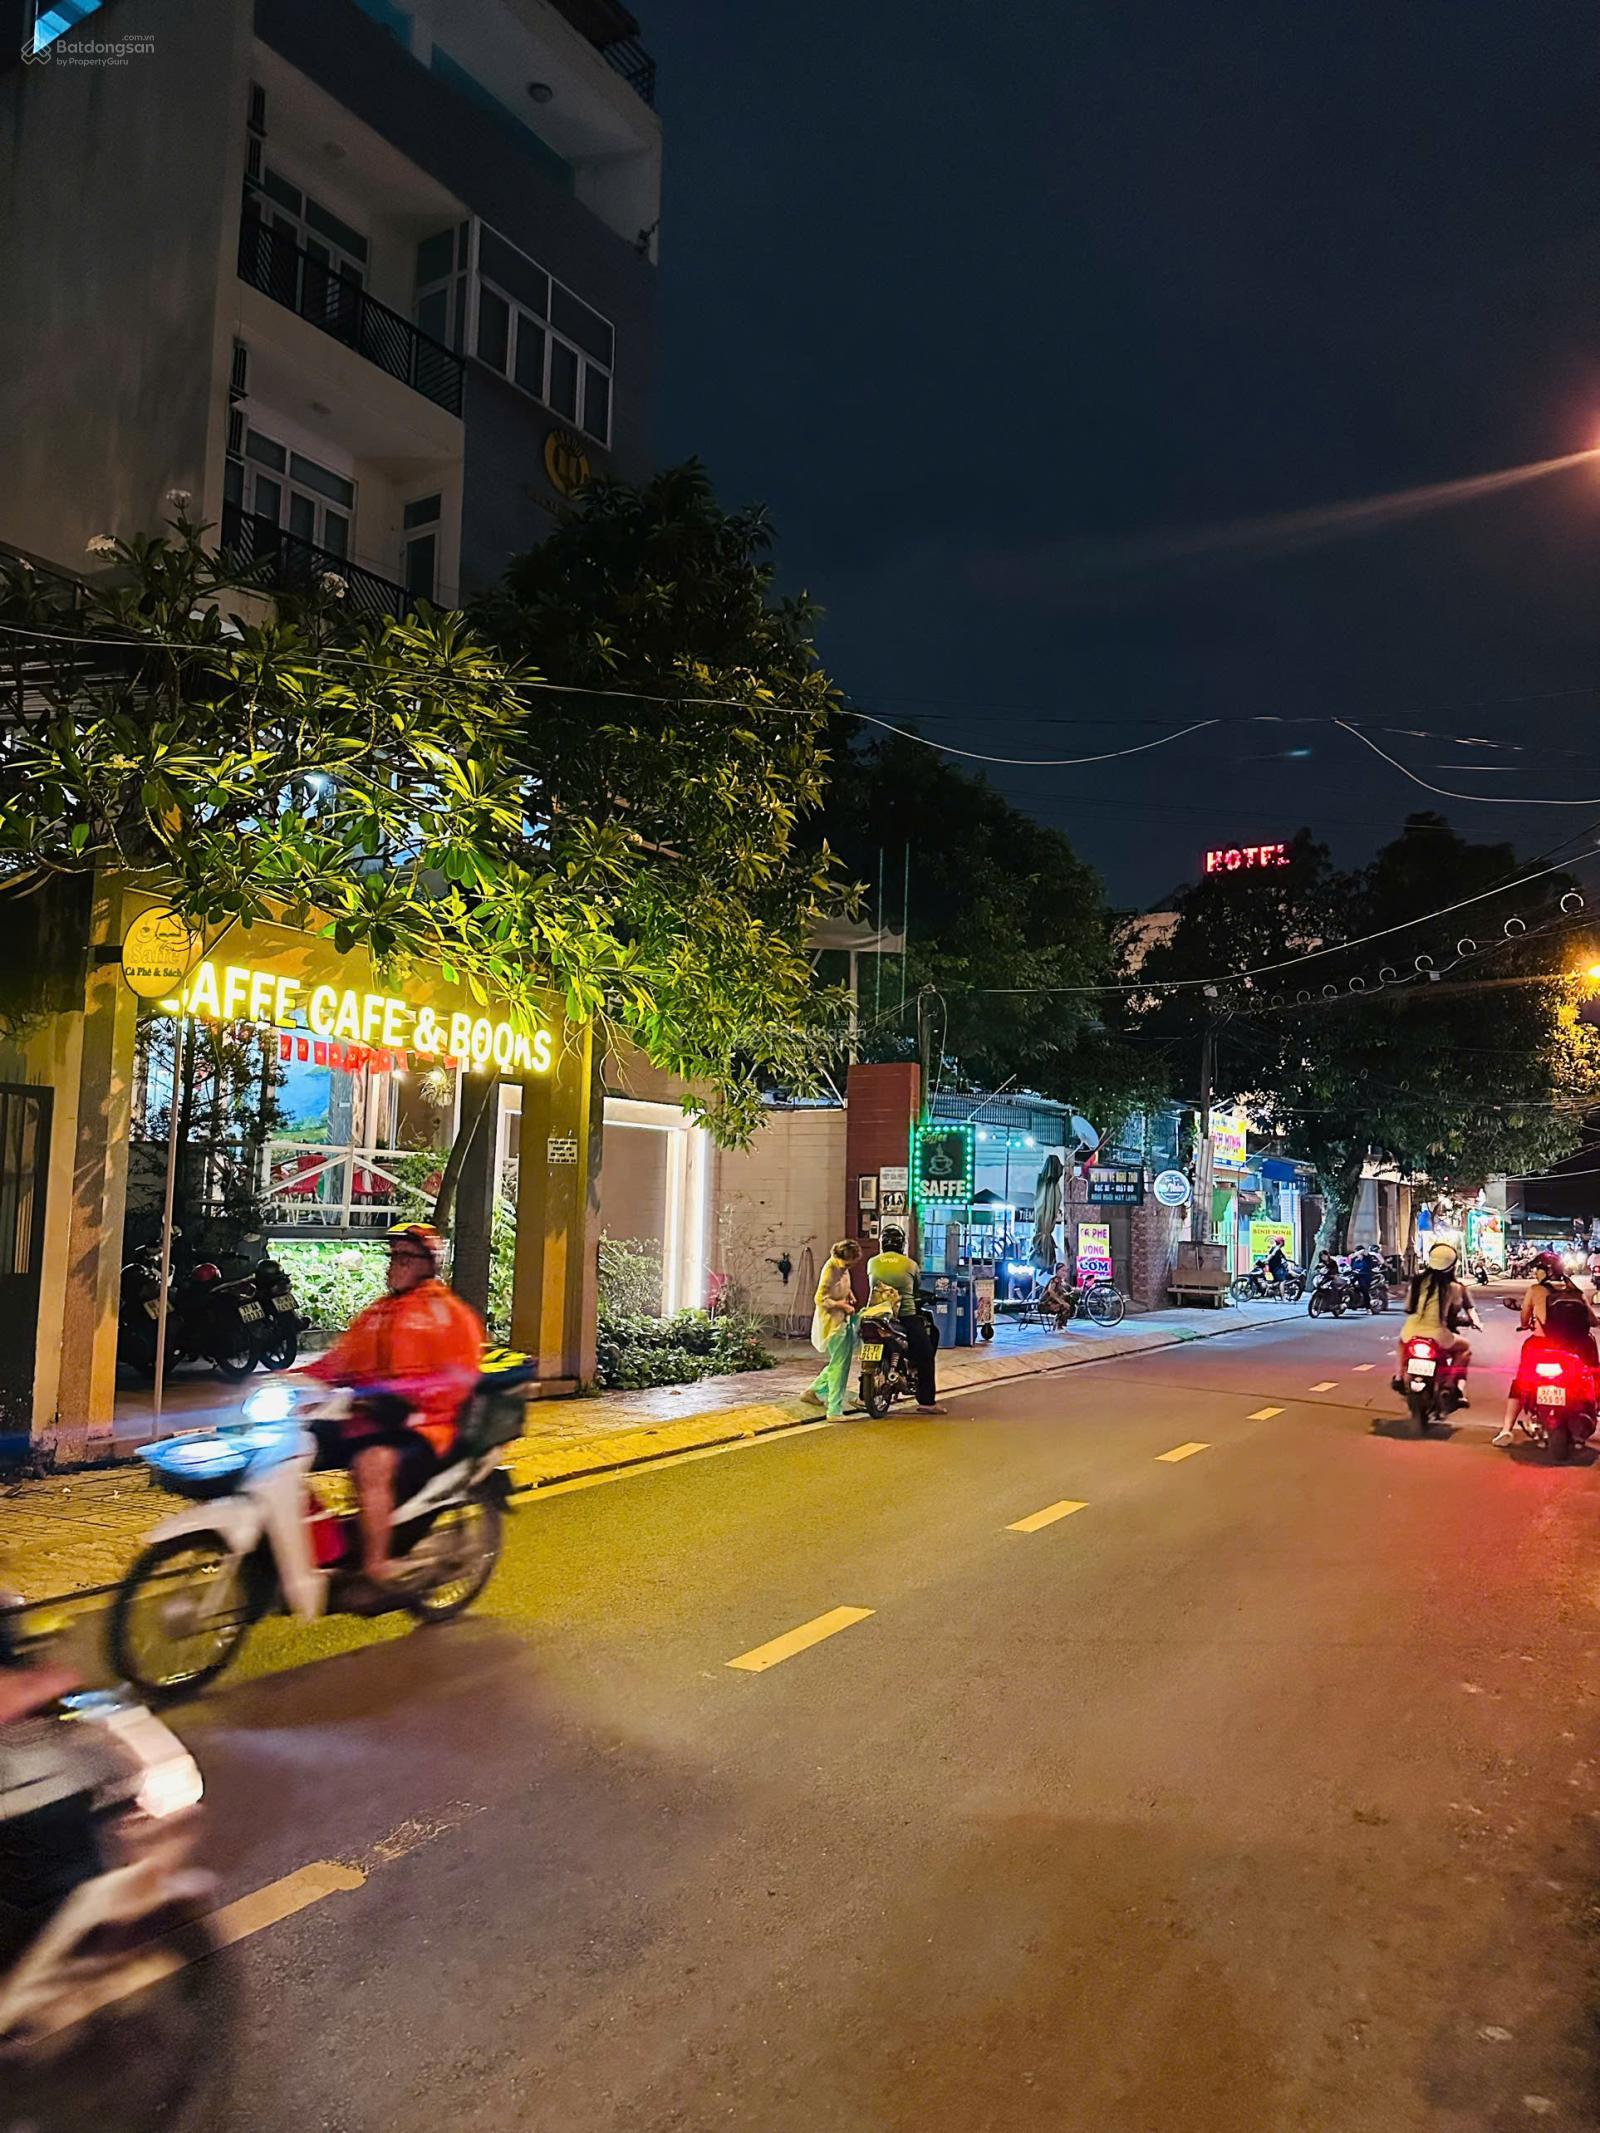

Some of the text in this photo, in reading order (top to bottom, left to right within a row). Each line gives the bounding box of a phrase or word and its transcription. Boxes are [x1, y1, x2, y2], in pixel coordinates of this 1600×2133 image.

[158, 961, 552, 1073] AFFE CAFE & BOOKS
[919, 1131, 948, 1144] Coffee
[919, 1179, 966, 1197] SAFFE
